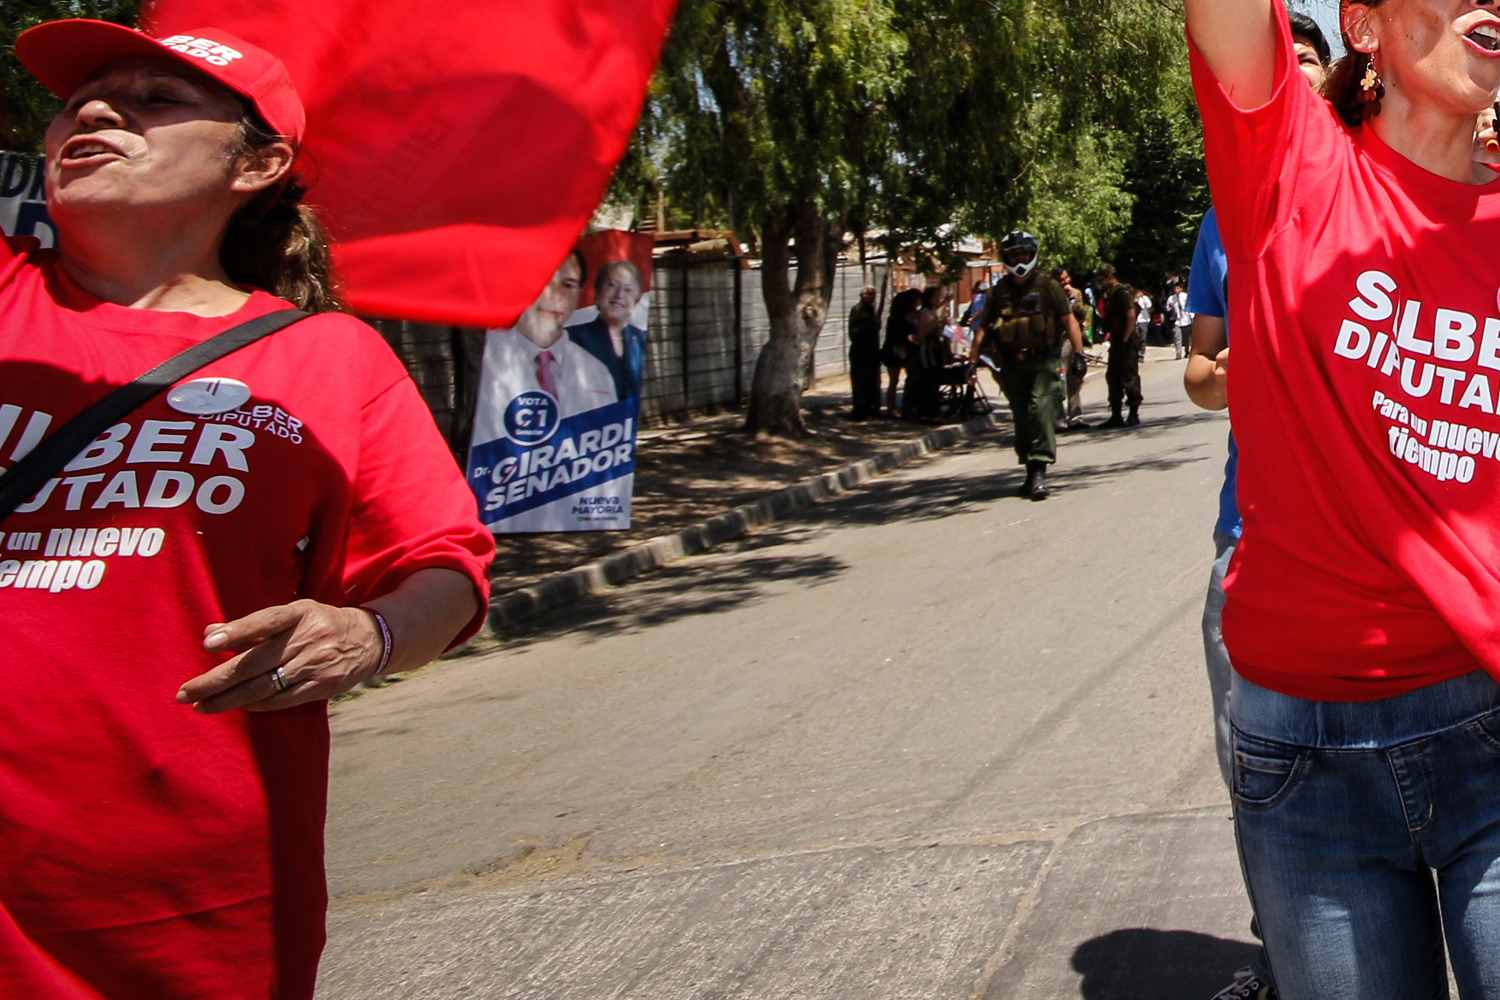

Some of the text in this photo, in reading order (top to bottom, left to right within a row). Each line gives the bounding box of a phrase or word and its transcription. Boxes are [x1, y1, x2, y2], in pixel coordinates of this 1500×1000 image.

[158, 35, 243, 62] BER
[517, 397, 549, 406] VOTA
[0, 403, 255, 473] ILBER
[1410, 412, 1427, 437] un
[491, 418, 633, 484] GIRARDI
[1388, 426, 1475, 484] tiempo
[13, 469, 245, 515] UTADO
[484, 443, 633, 511] SENADOR
[7, 527, 165, 557] un nuevo
[0, 559, 106, 593] empo
